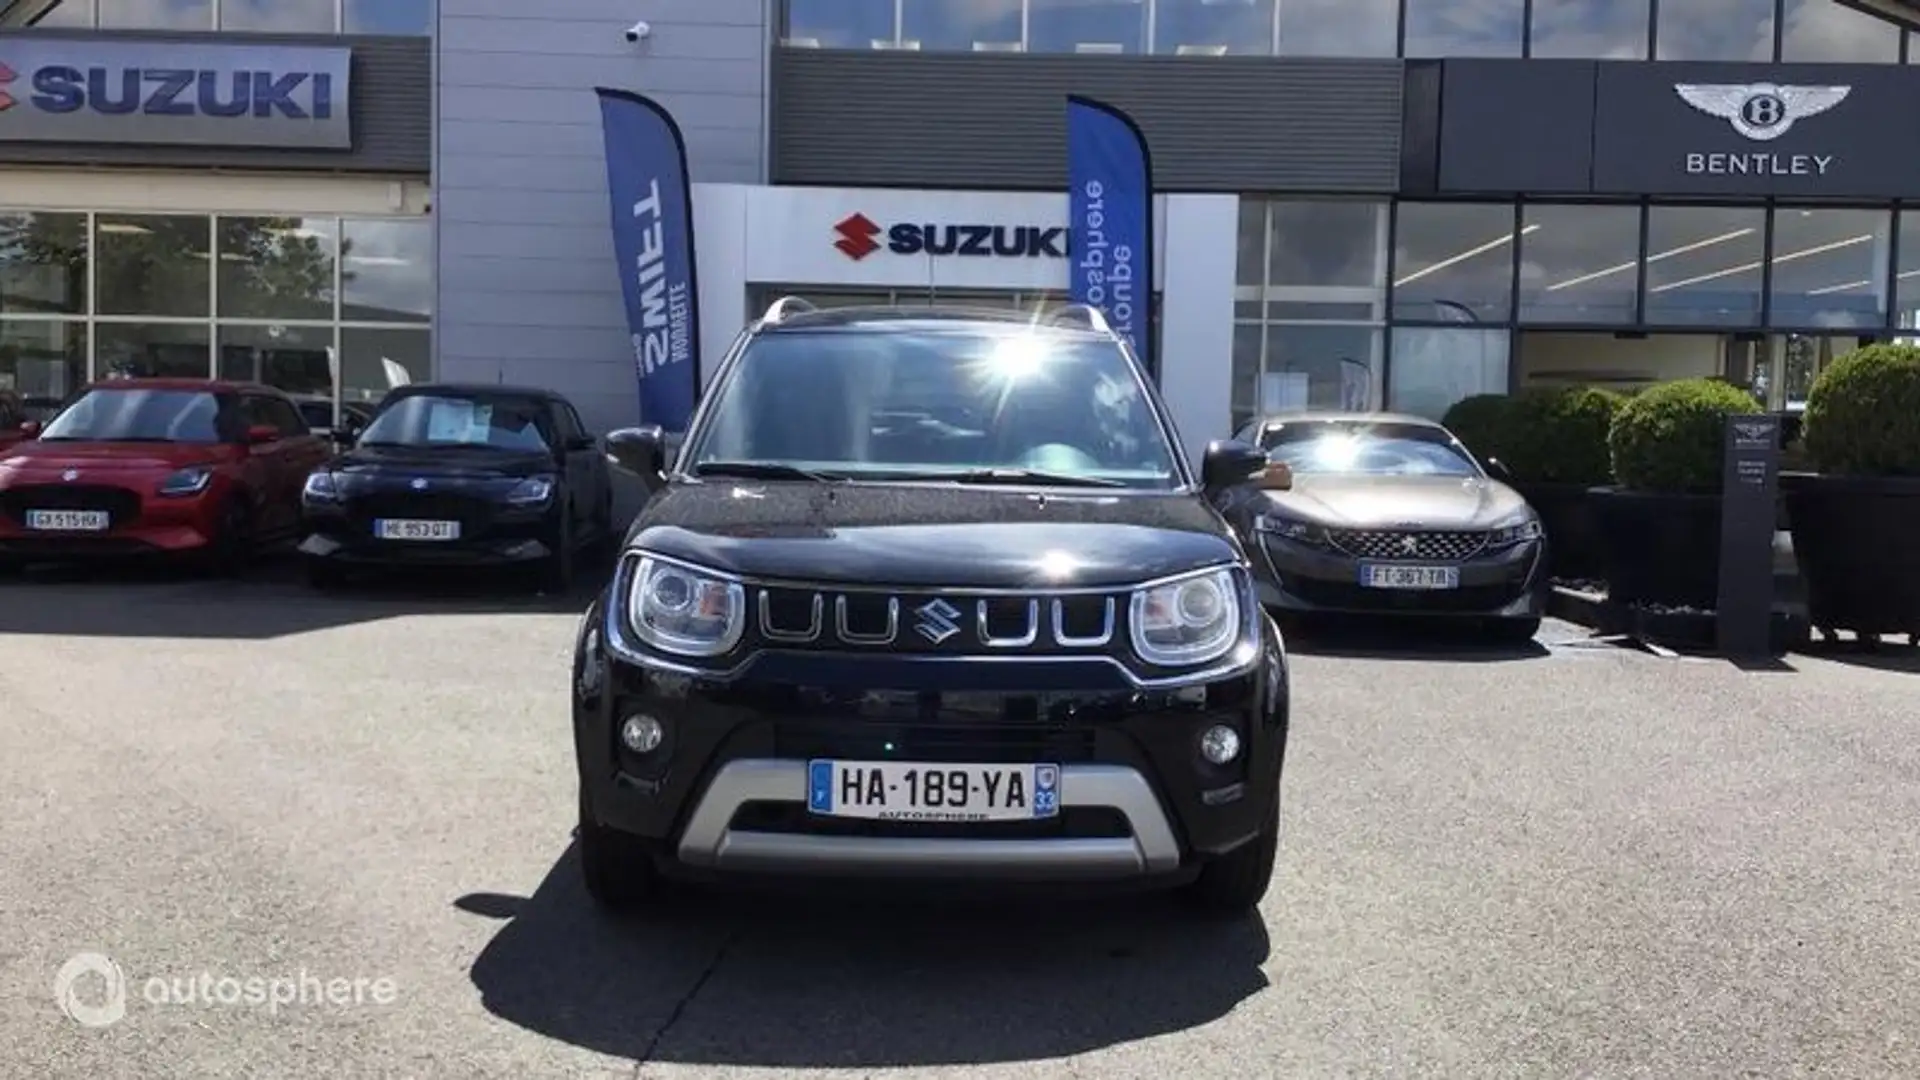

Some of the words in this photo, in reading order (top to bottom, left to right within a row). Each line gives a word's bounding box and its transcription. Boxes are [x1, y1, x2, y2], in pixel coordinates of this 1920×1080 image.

[30, 65, 332, 119] SUZUKI
[1686, 152, 1832, 175] BENTLEY
[841, 768, 1026, 808] HA-189-YA
